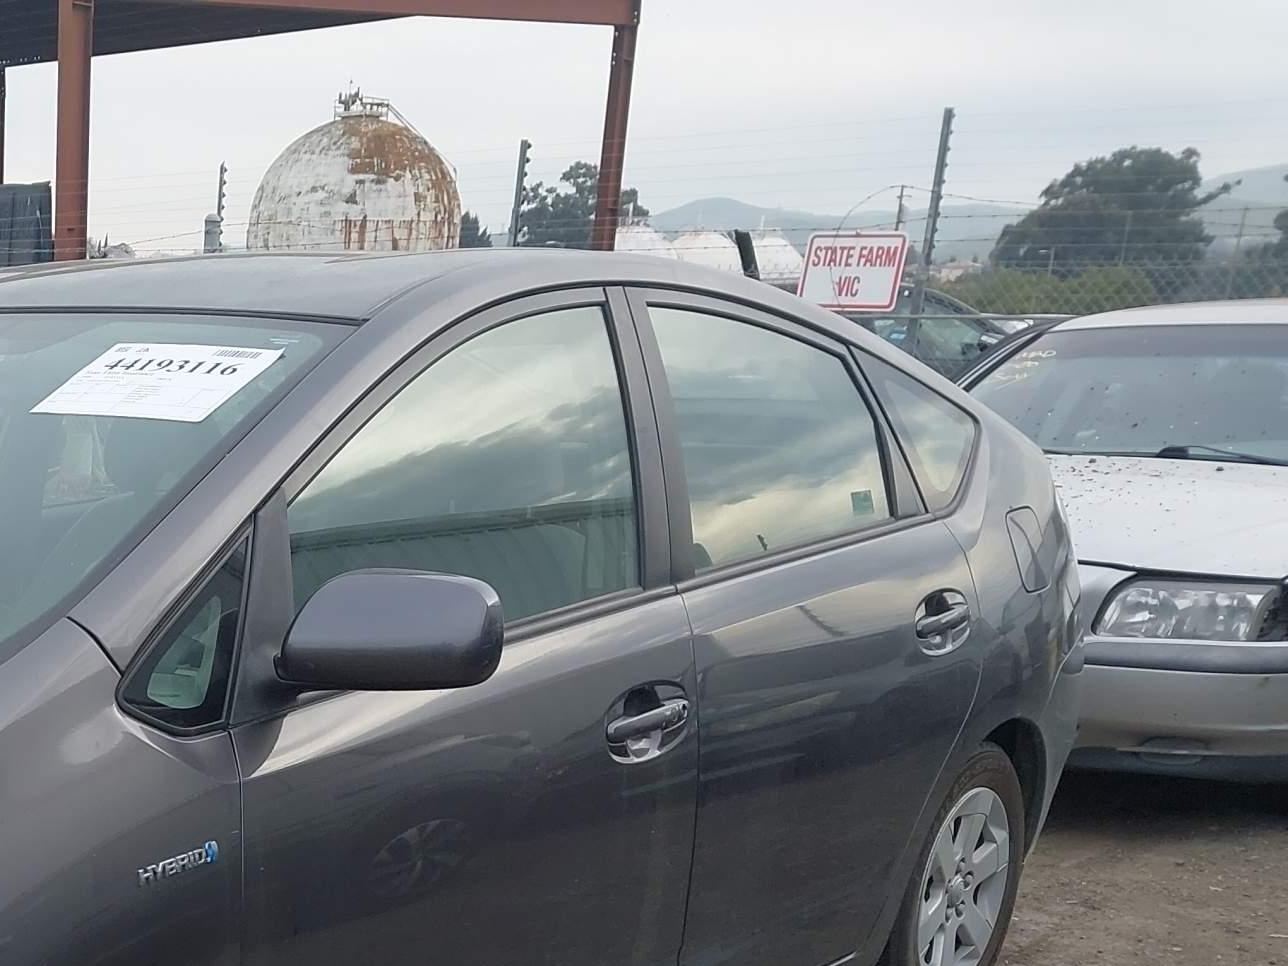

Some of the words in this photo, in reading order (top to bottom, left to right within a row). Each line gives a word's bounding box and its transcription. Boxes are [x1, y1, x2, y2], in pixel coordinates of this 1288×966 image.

[811, 246, 855, 268] STATE
[857, 246, 900, 268] FARM
[836, 275, 861, 298] VIC
[104, 357, 243, 376] 44193116
[137, 848, 207, 886] HYBRID
